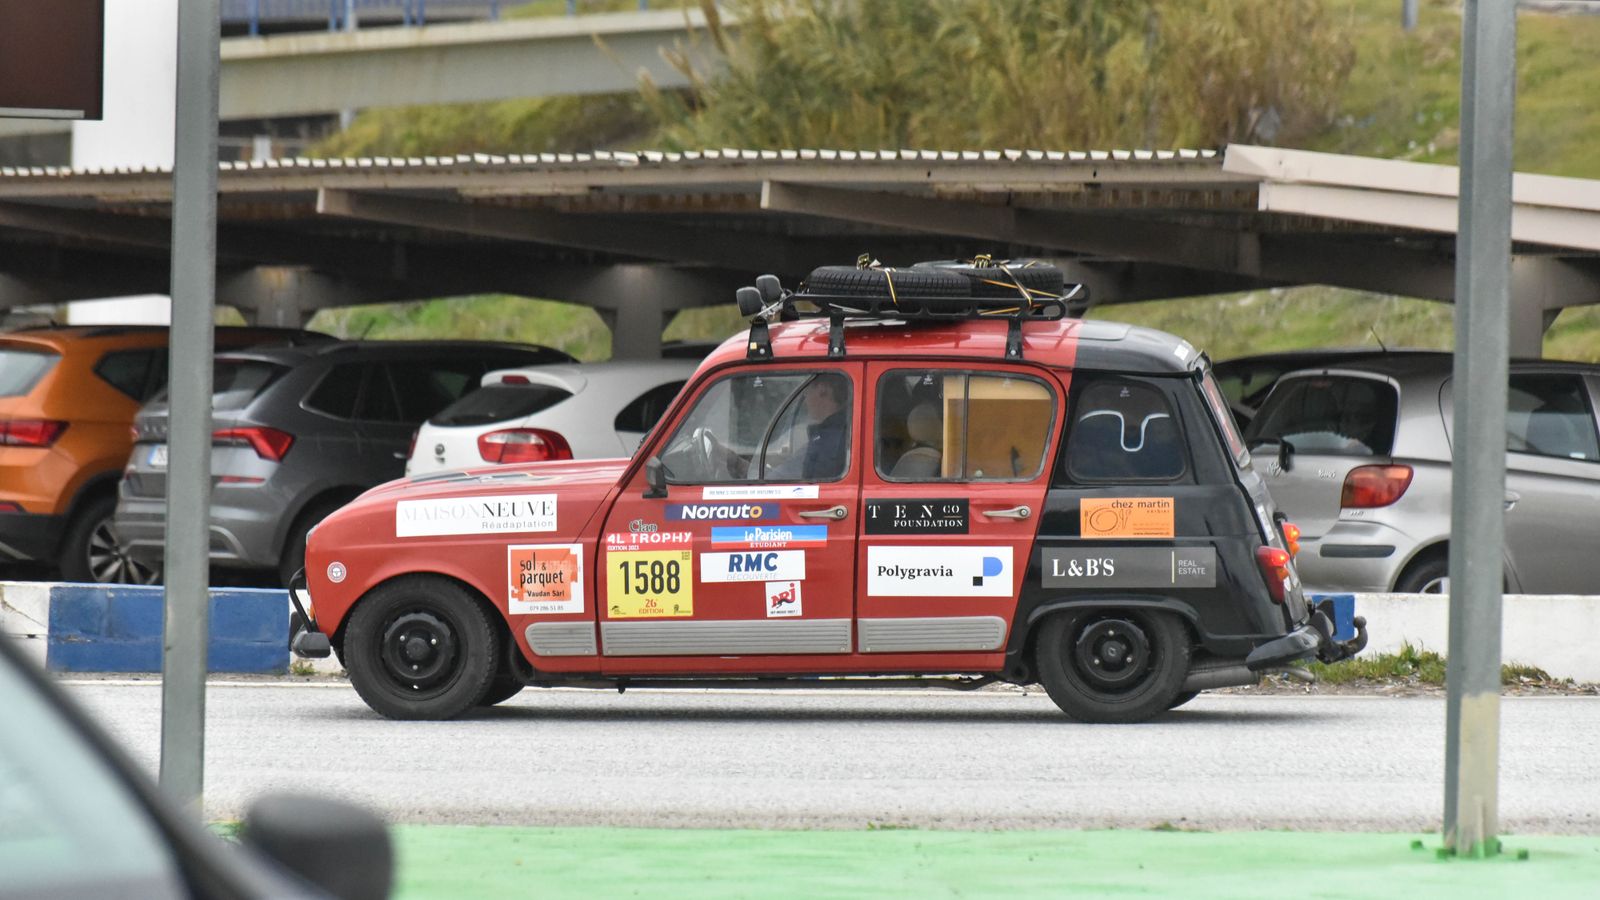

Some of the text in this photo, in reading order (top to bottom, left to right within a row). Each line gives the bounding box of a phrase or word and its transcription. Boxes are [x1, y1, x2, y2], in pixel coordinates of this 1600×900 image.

[1111, 499, 1170, 508] chez martin
[681, 504, 762, 519] Norauto
[481, 520, 553, 529] Réadaptation
[893, 519, 963, 527] FOUNDATION
[607, 531, 692, 544] 4L TROPHY
[744, 527, 792, 541] Le Parisien
[519, 551, 536, 571] sol
[728, 553, 778, 572] RMC
[1178, 559, 1197, 567] REAL
[619, 559, 681, 595] 1588
[877, 565, 953, 580] Polygravia
[1178, 567, 1206, 575] ESTATE
[519, 569, 564, 588] parquet
[527, 589, 551, 597] Vaudan
